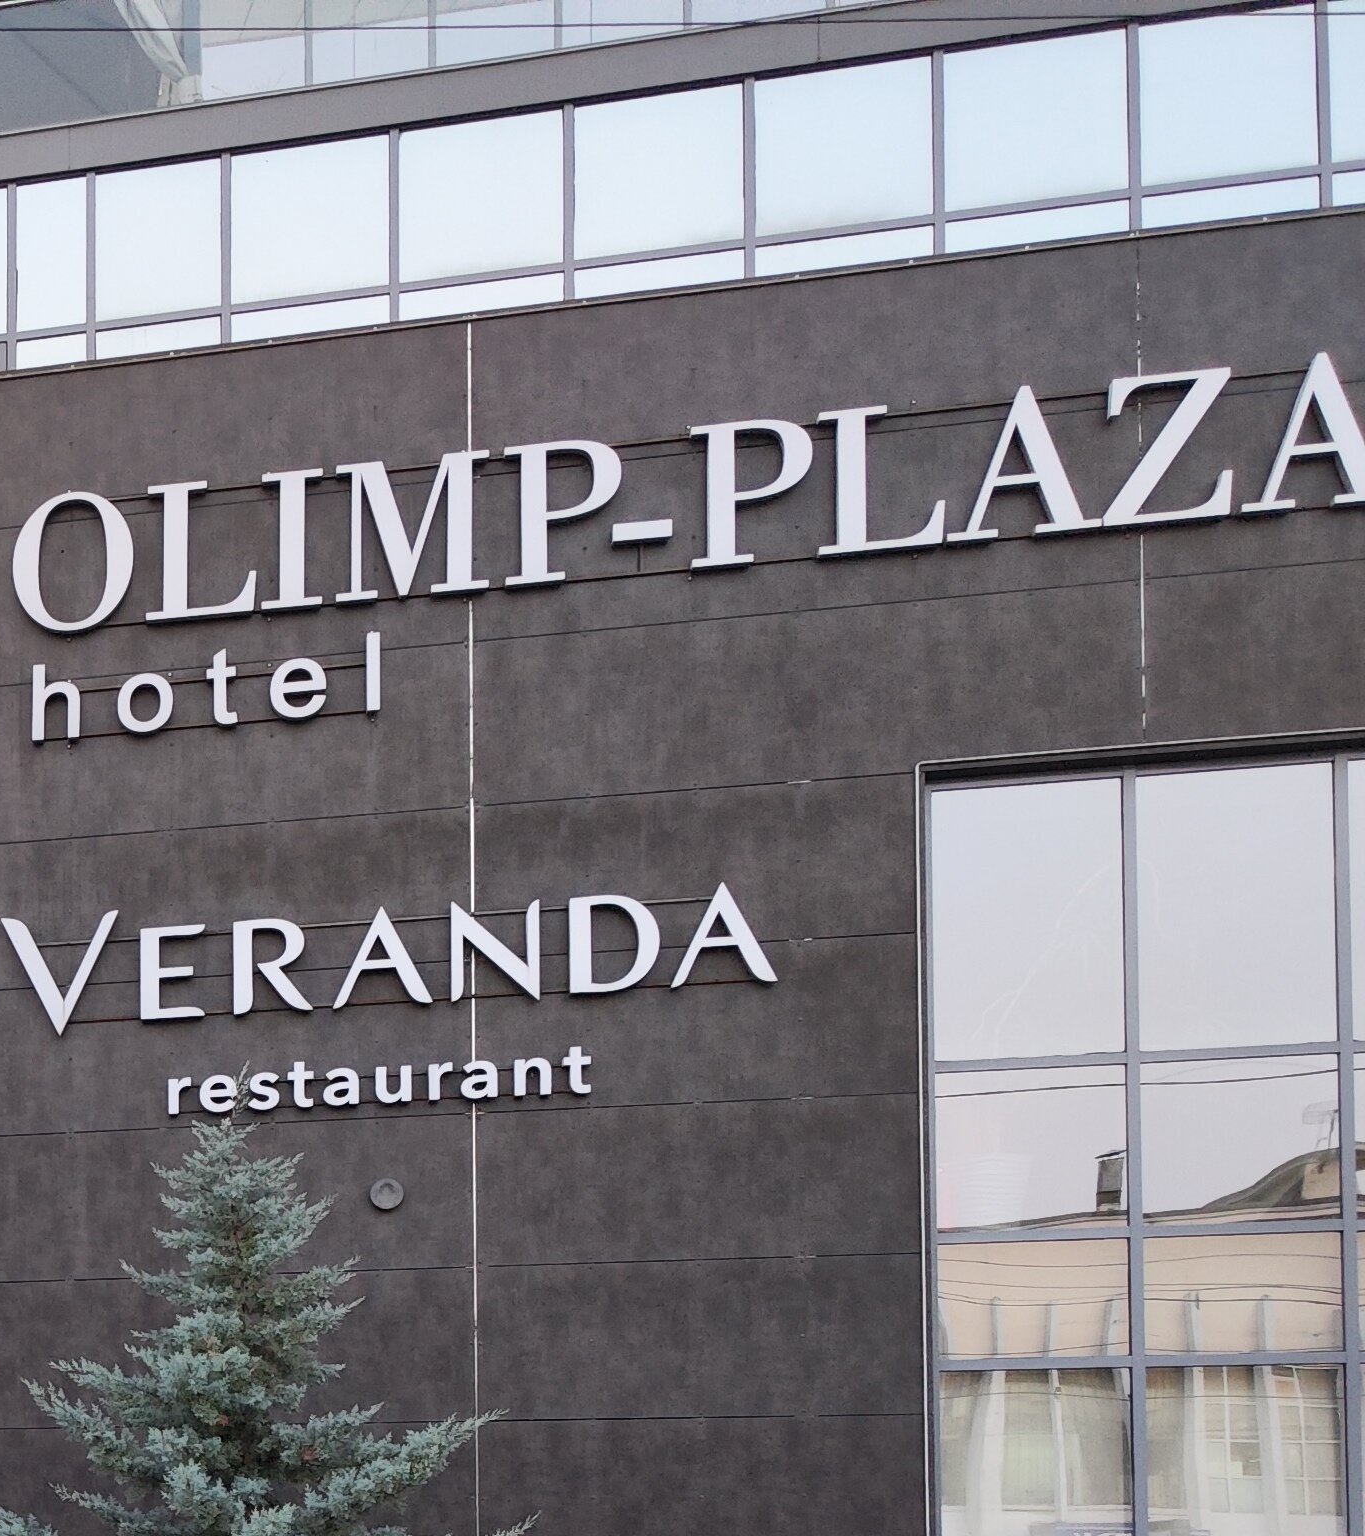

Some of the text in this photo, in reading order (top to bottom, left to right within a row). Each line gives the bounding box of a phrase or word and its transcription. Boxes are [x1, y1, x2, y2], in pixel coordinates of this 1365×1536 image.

[11, 350, 1365, 634] OLIMP-PLAZA
[30, 630, 382, 742] hotel
[0, 882, 779, 1036] VERANDA
[167, 1045, 593, 1116] restaurant
